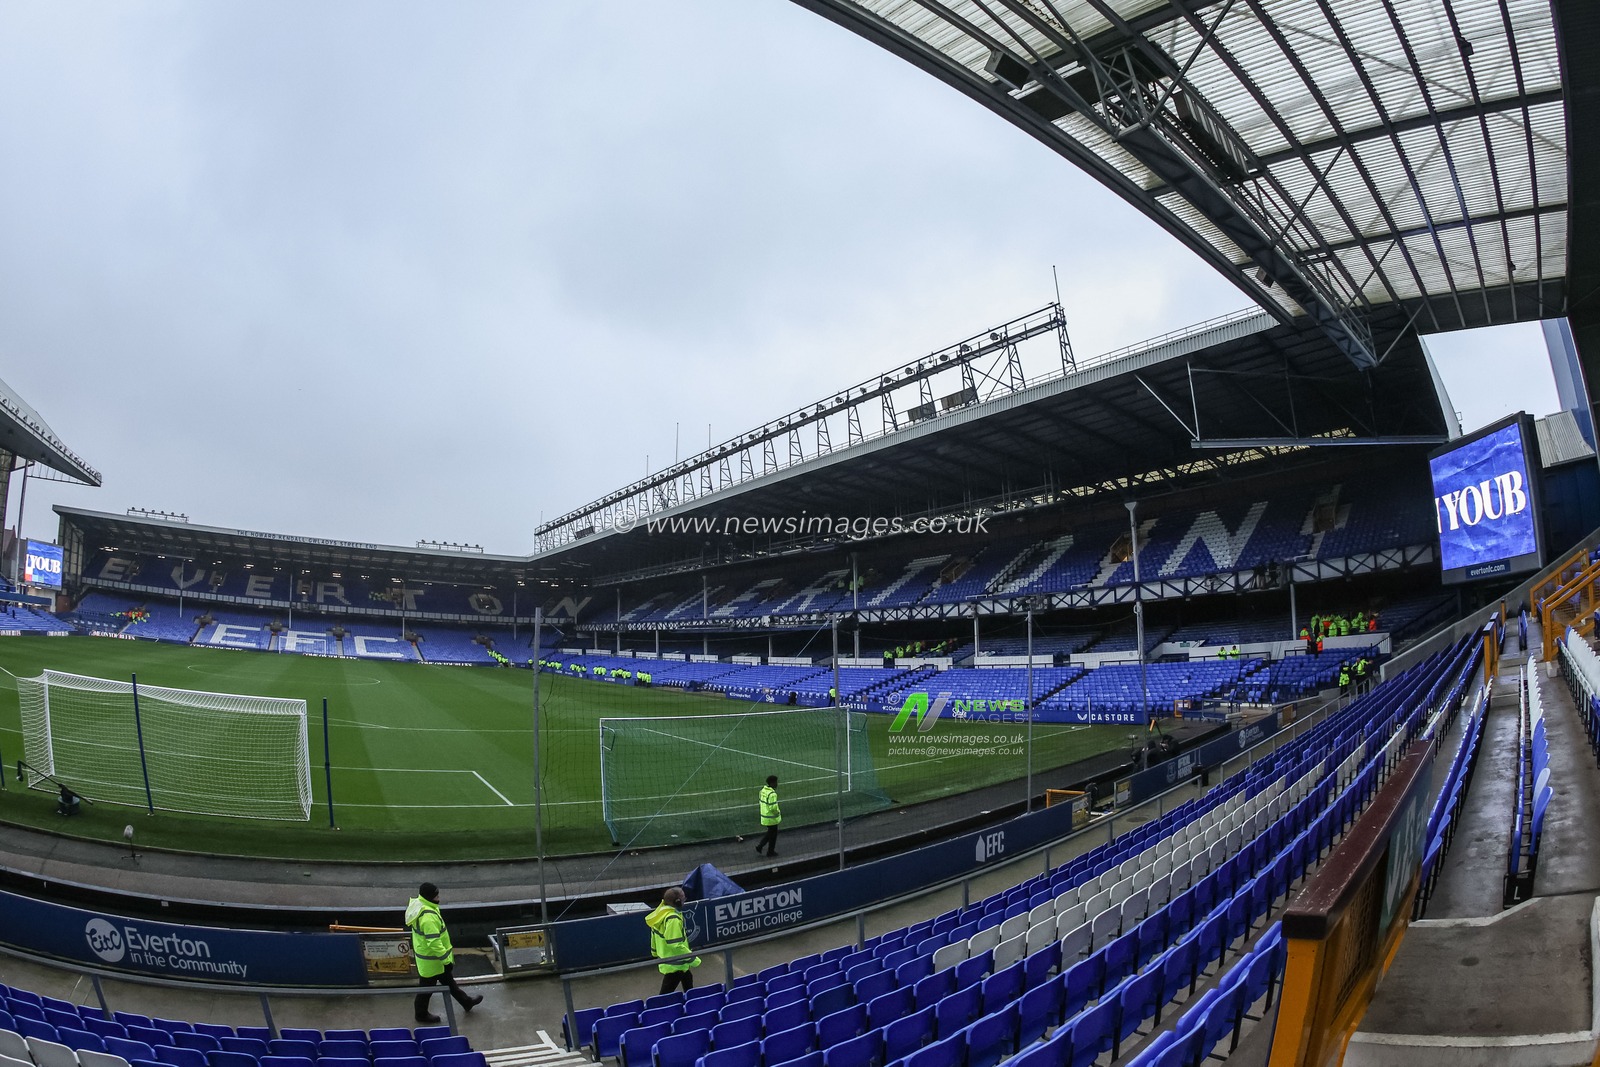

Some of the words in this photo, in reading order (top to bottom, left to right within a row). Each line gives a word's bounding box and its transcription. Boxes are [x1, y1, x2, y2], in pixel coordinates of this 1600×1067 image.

[251, 531, 276, 539] HOWARD
[278, 534, 306, 543] KENDALL
[1091, 713, 1135, 722] CASTORE
[986, 830, 1005, 857] EFC
[715, 888, 803, 921] EVERTON
[1513, 886, 1521, 900] L
[716, 917, 761, 938] Football
[763, 910, 803, 927] College
[124, 926, 211, 958] Everton
[130, 949, 143, 963] in
[144, 952, 166, 967] the
[169, 955, 248, 978] Community
